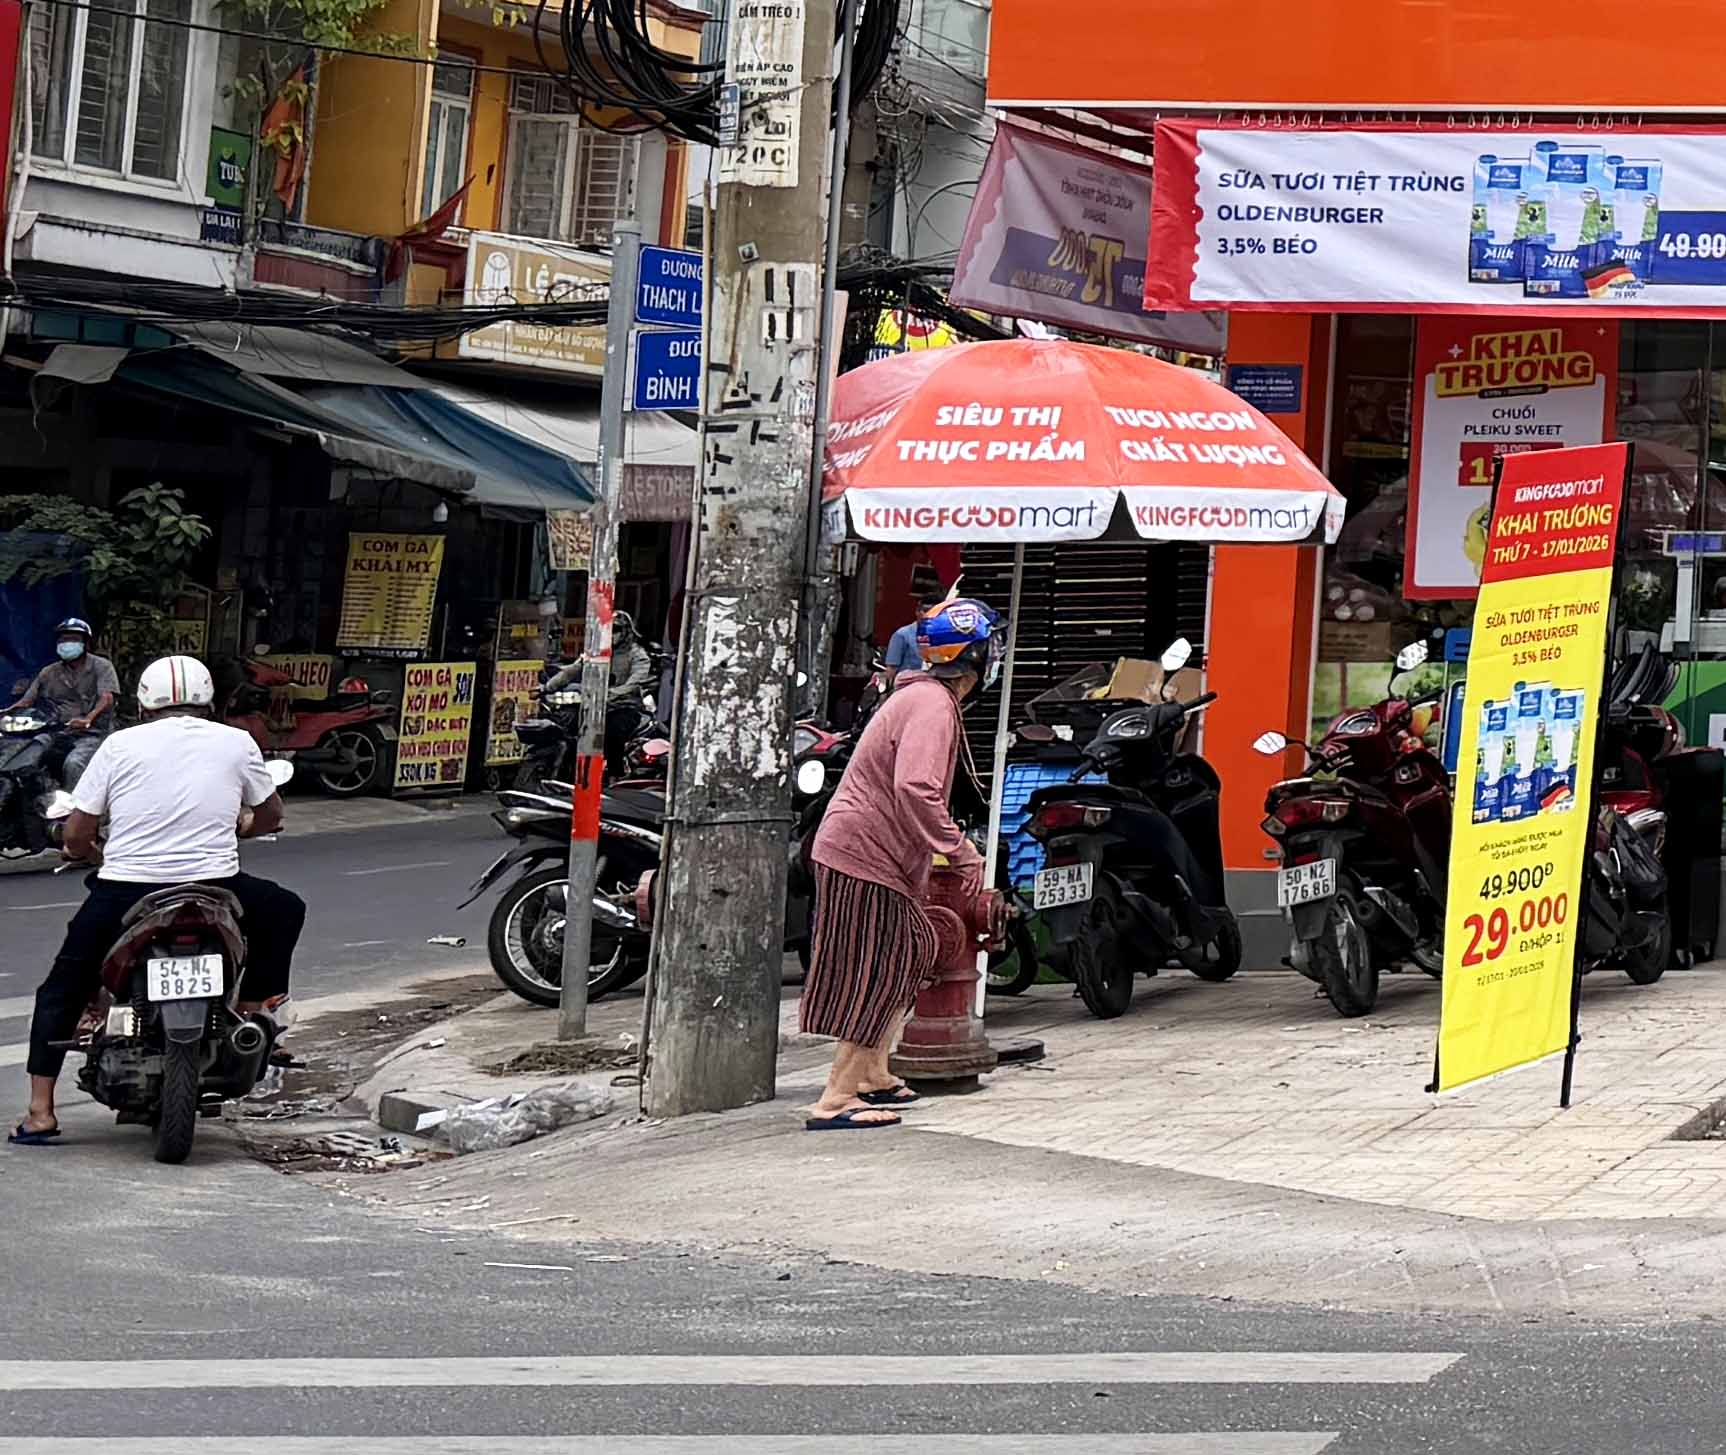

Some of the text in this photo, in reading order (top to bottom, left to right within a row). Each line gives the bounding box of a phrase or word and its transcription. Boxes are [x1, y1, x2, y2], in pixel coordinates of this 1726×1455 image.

[773, 64, 794, 72] CAO
[1218, 169, 1465, 199] SỮA TƯƠI TIỆT TRÙNG
[1217, 203, 1385, 226] OLDENBURGER
[1217, 233, 1318, 258] 3,5% BÉO
[1483, 246, 1514, 261] Milk
[1542, 253, 1580, 269] Milk
[642, 284, 686, 317] THẠCH
[1472, 331, 1558, 359] KHAI
[646, 369, 691, 401] BÌNH
[1440, 354, 1594, 390] TRƯƠNG
[935, 399, 1062, 430] SIÊU THỊ
[1104, 404, 1257, 432] TƯƠI NGON
[1464, 423, 1564, 437] PLEIKU SWEET
[897, 439, 980, 464] THỰC
[985, 432, 1085, 462] PHẨM
[863, 499, 1098, 529] KINGFOODmart
[1135, 501, 1312, 530] KINGFOODmart
[1496, 501, 1614, 538] KHAI TRƯƠNG
[1491, 540, 1519, 564] THỨ
[1541, 533, 1609, 557] 17/01/2026
[1485, 607, 1507, 631] SỮA
[1509, 605, 1536, 627] TƯƠI
[1564, 597, 1601, 620] TRÙNG
[1500, 622, 1580, 646] OLDENBURGER
[1539, 643, 1563, 663] BÉO
[1286, 865, 1326, 885] 50-N2
[1039, 883, 1087, 905] 253.33
[1284, 883, 1330, 904] 176.86
[1461, 892, 1568, 968] 29.000
[160, 977, 212, 996] 8825
